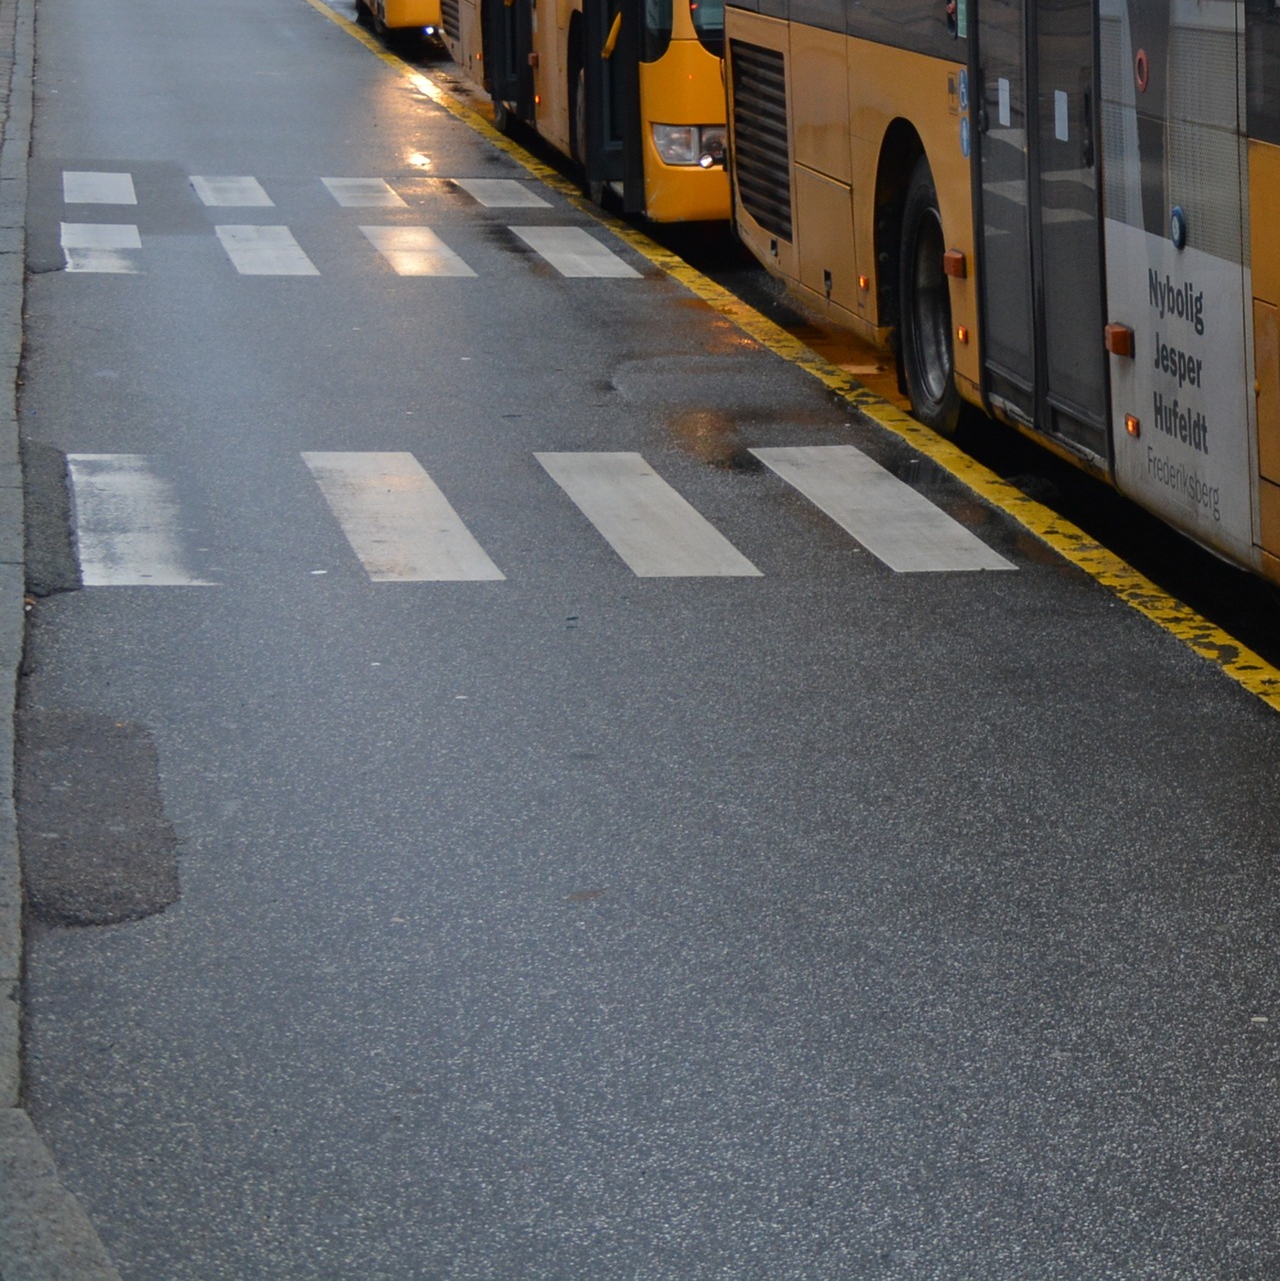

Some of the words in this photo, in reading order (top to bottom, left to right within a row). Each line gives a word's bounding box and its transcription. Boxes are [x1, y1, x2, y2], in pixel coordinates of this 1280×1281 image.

[1149, 268, 1205, 336] Nybolig
[1154, 331, 1203, 389] Jesper
[1154, 390, 1209, 455] Hufeldt
[1147, 445, 1221, 522] Frederiksberg
